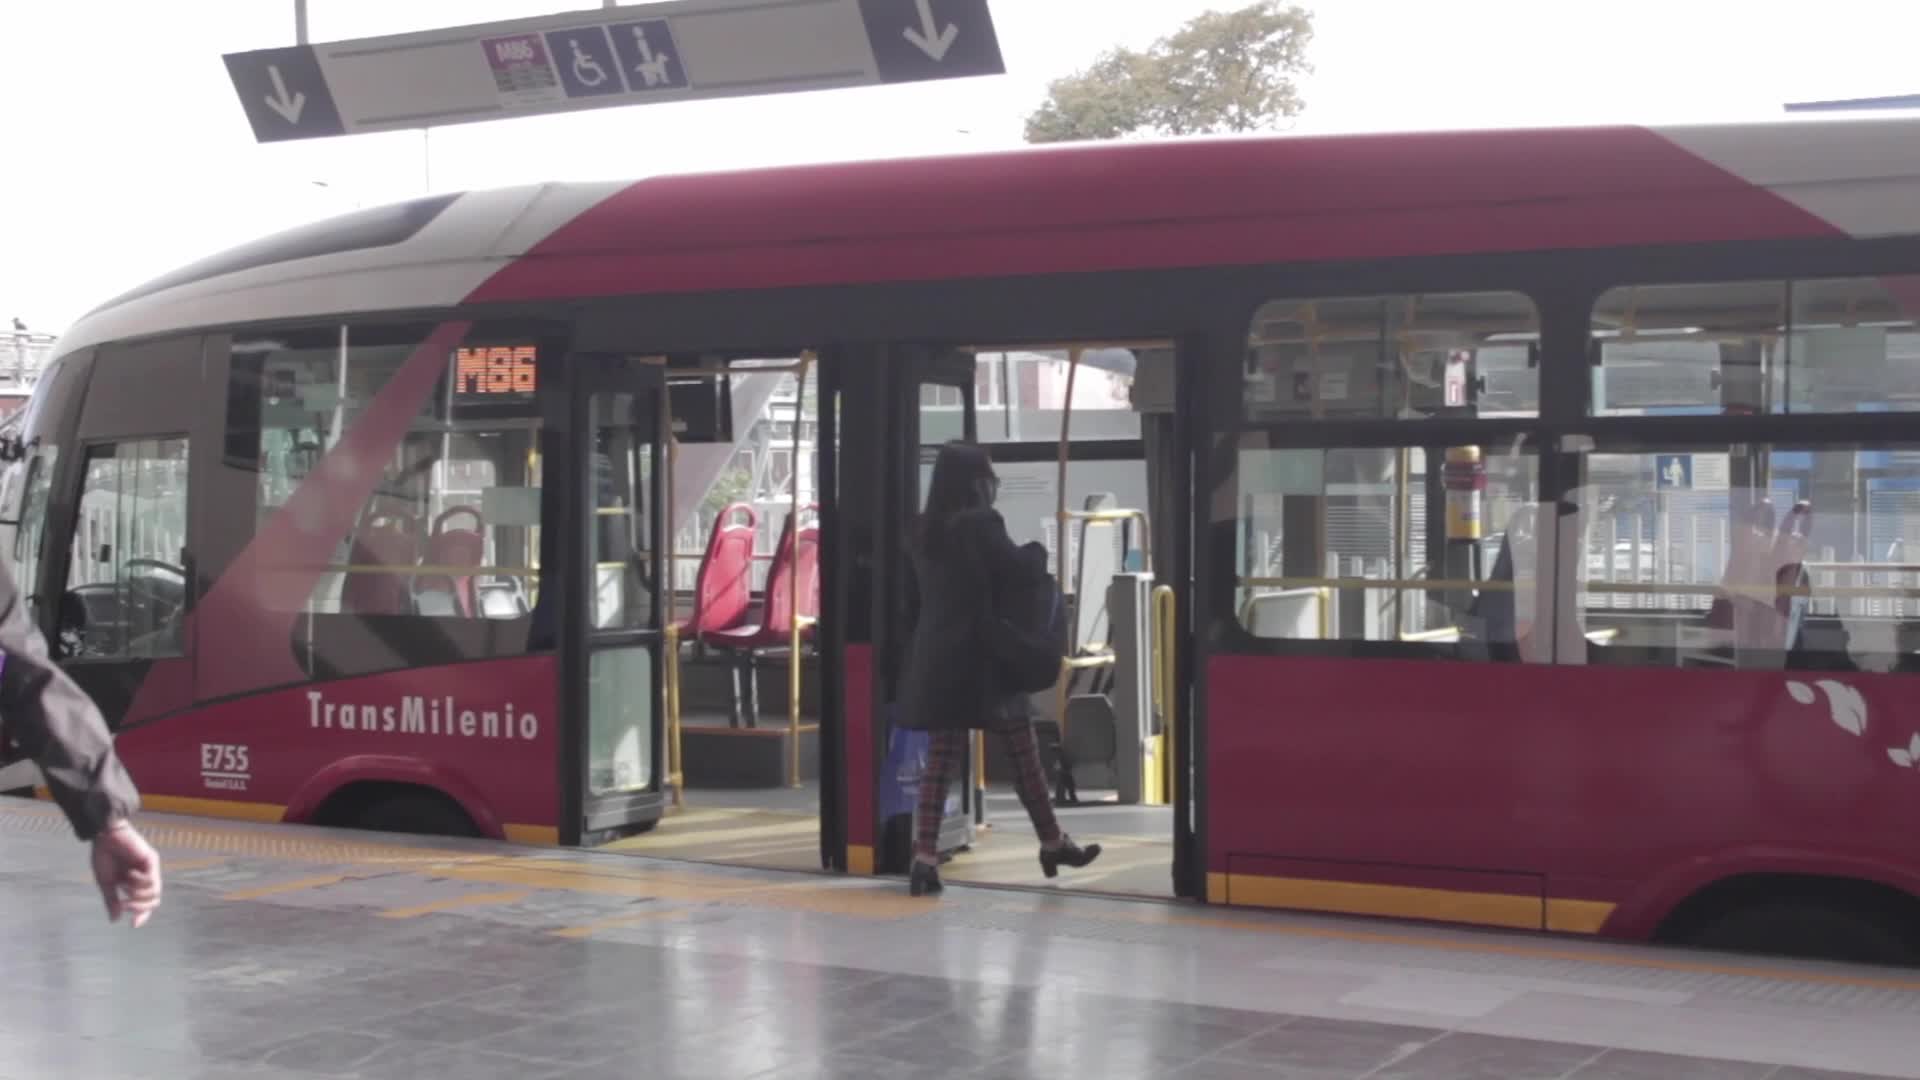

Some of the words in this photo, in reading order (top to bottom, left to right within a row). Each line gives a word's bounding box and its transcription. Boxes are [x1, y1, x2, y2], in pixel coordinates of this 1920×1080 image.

[456, 346, 536, 393] M86
[307, 691, 538, 740] TransMilenio
[201, 743, 249, 771] E755
